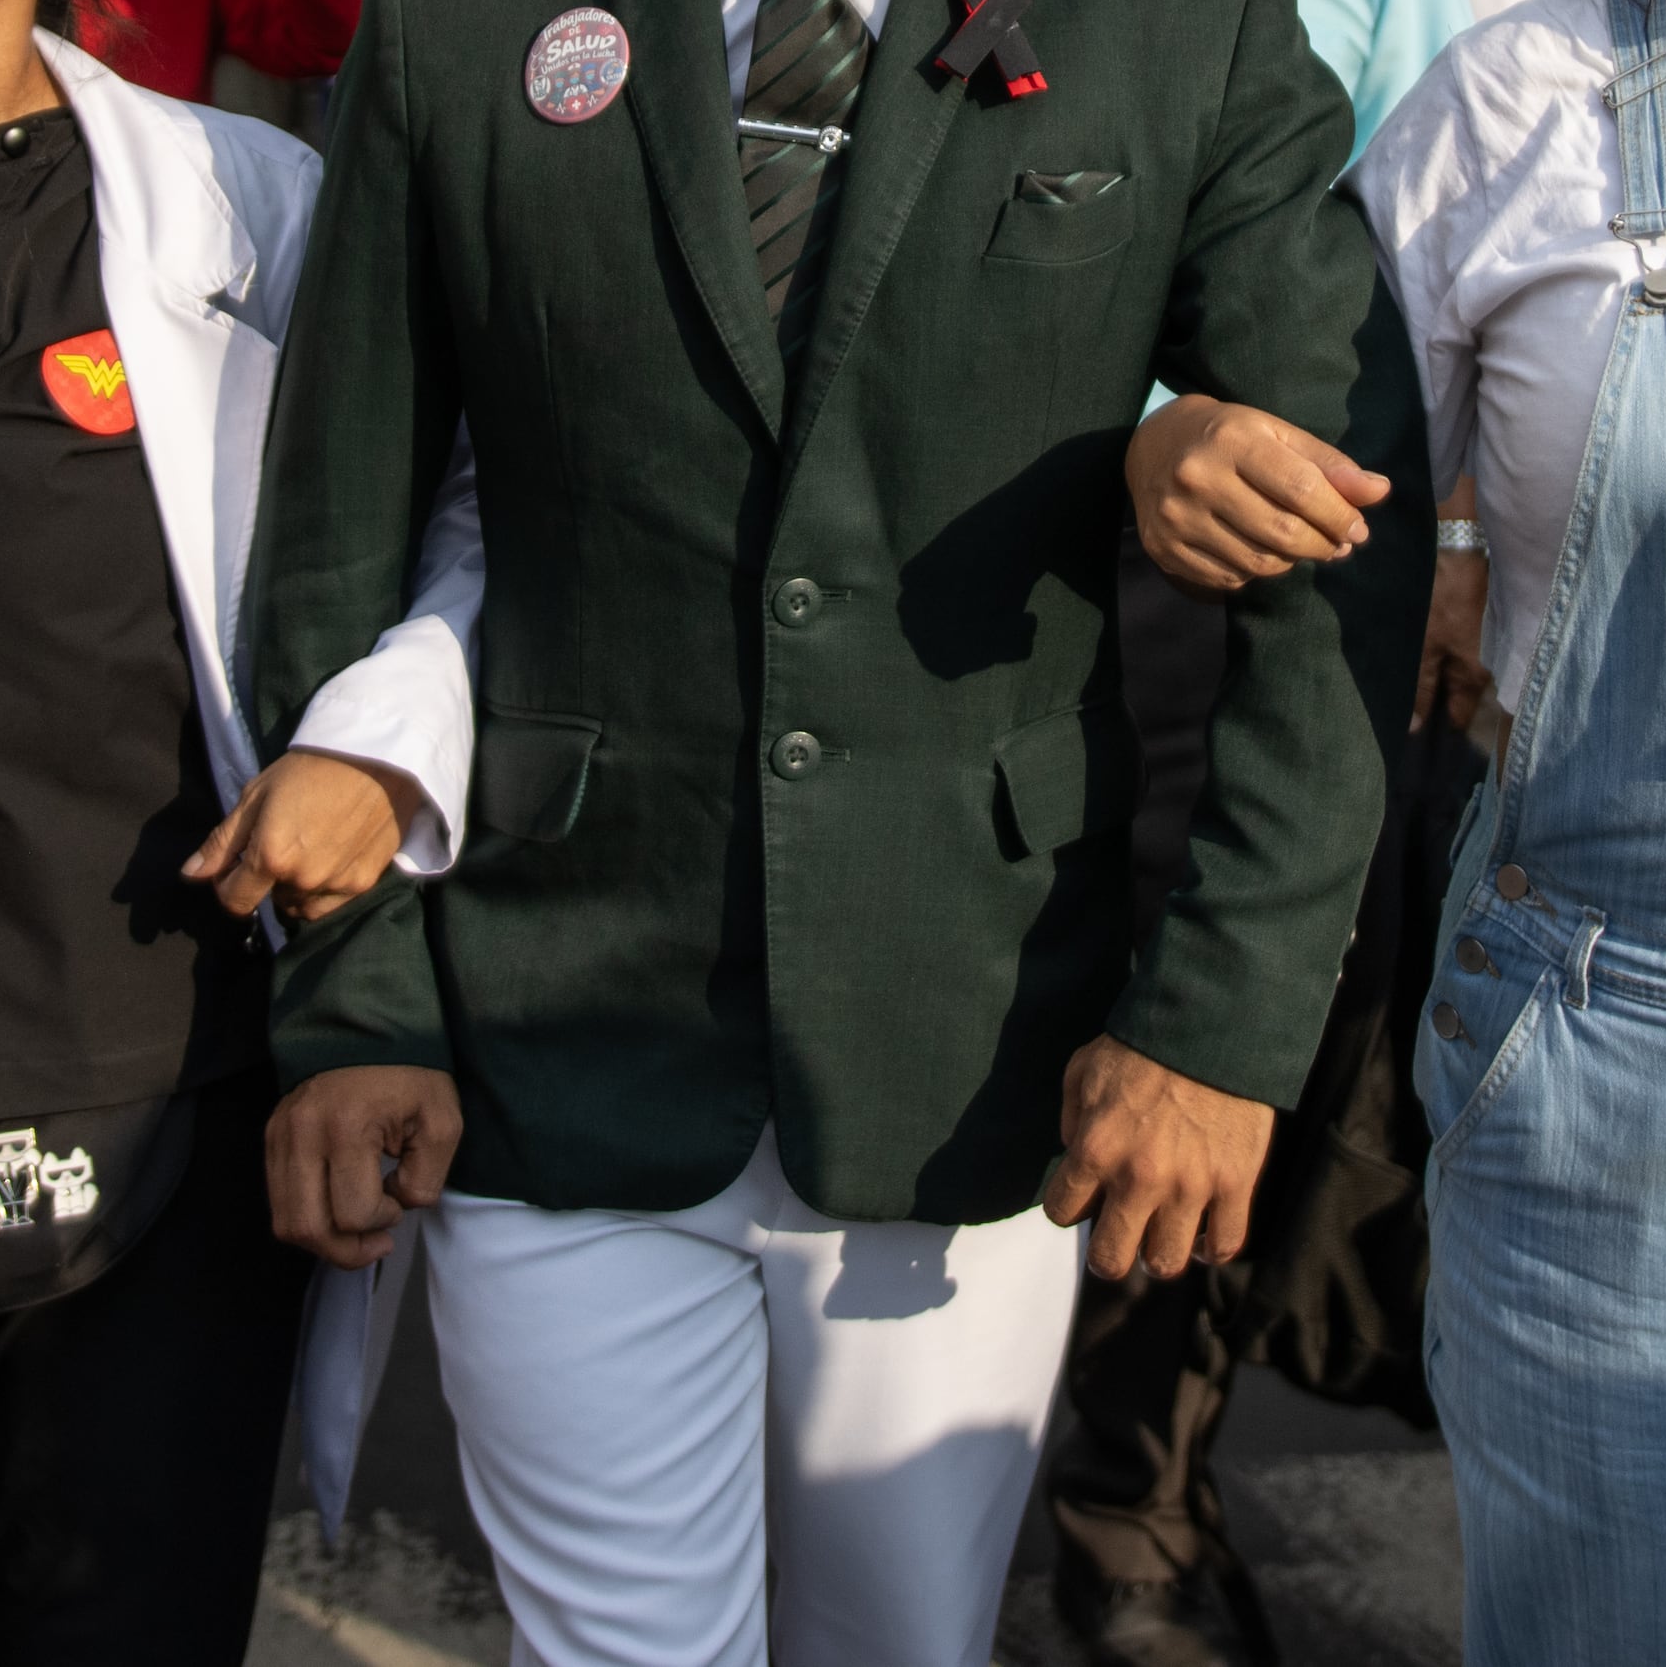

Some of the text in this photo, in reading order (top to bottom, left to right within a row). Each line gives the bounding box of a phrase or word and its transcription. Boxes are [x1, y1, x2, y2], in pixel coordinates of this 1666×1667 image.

[543, 9, 615, 41] Trabajadores
[568, 25, 581, 36] DE
[546, 34, 617, 63] SALUD
[541, 58, 569, 75] Unidos
